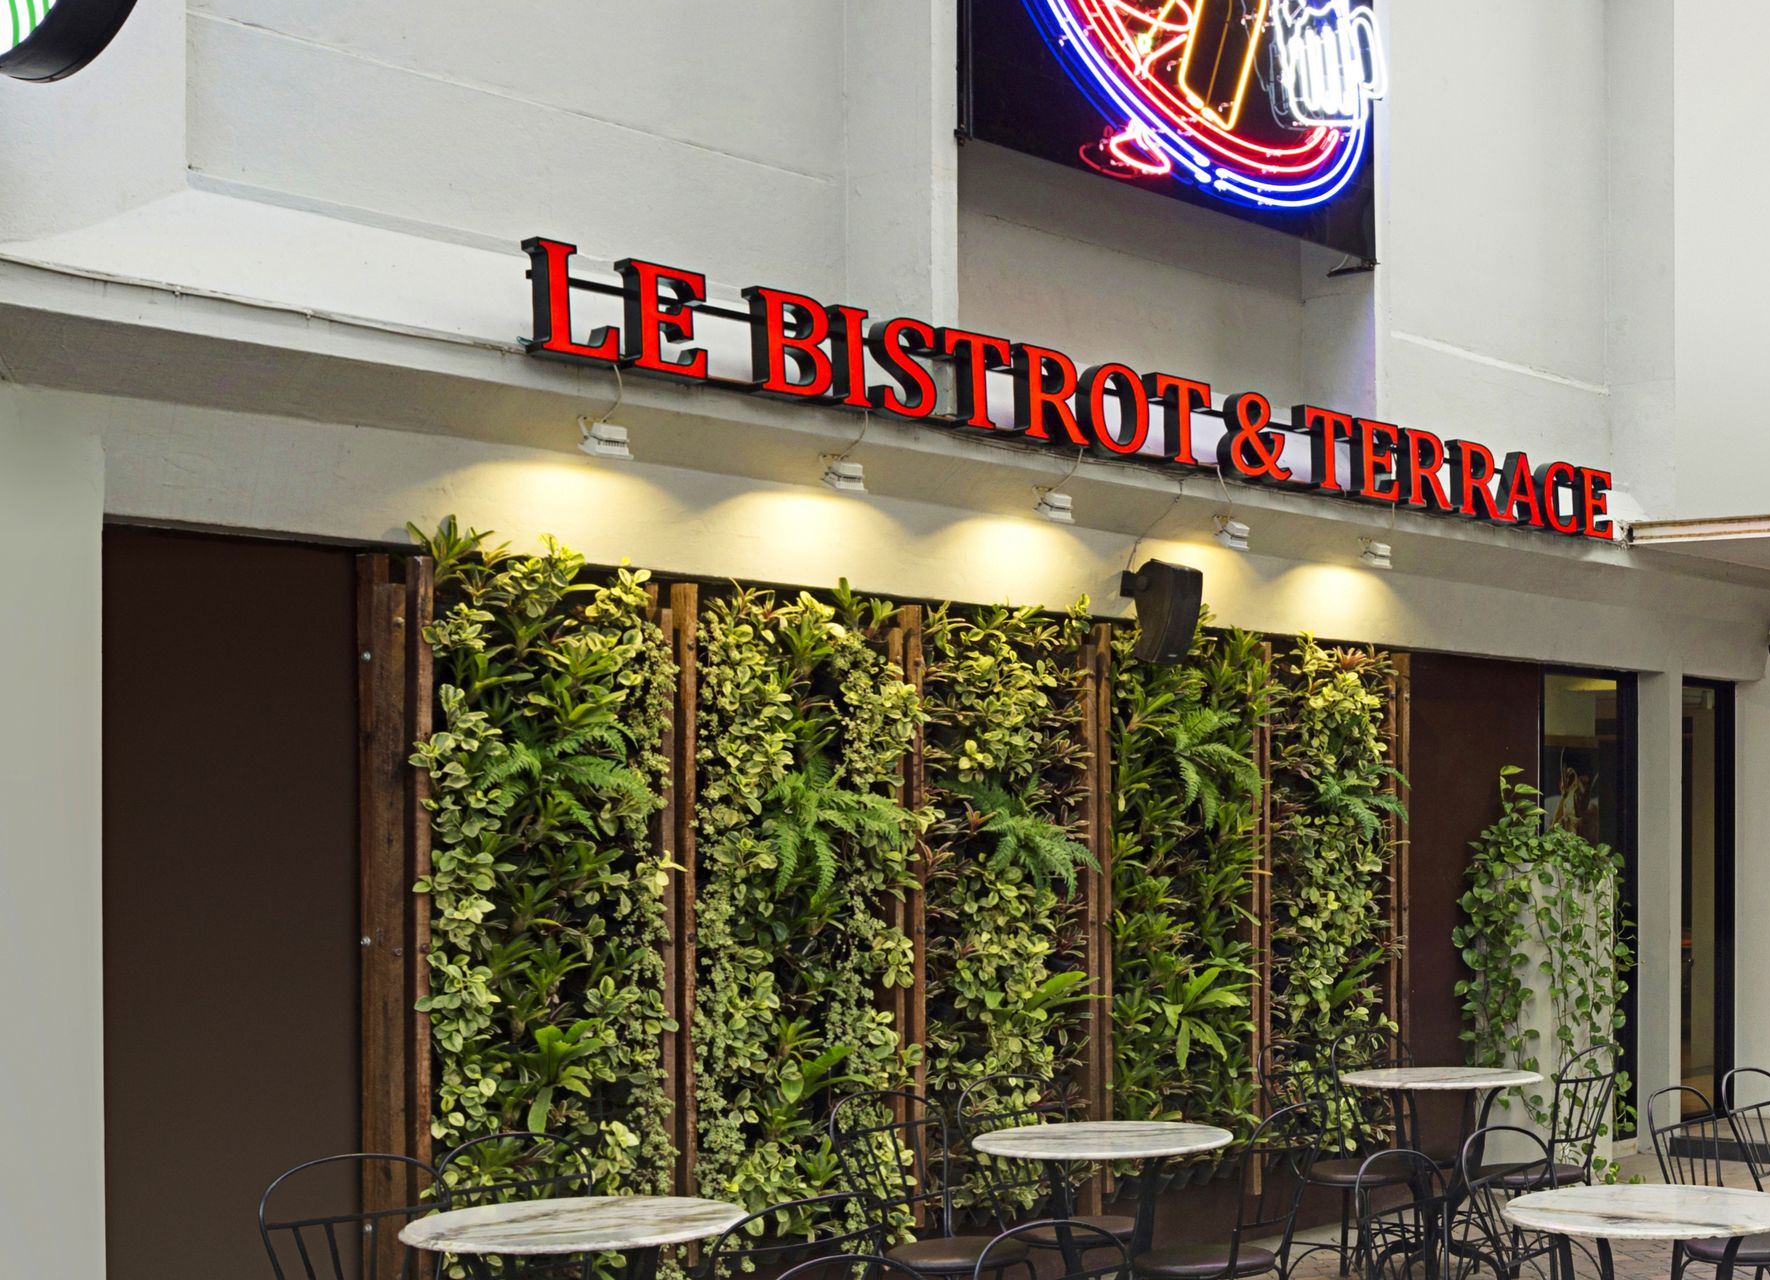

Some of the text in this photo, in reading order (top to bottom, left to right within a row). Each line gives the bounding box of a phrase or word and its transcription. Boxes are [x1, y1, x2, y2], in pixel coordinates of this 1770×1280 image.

[523, 236, 1614, 541] LE BISTROT & TERRACE
